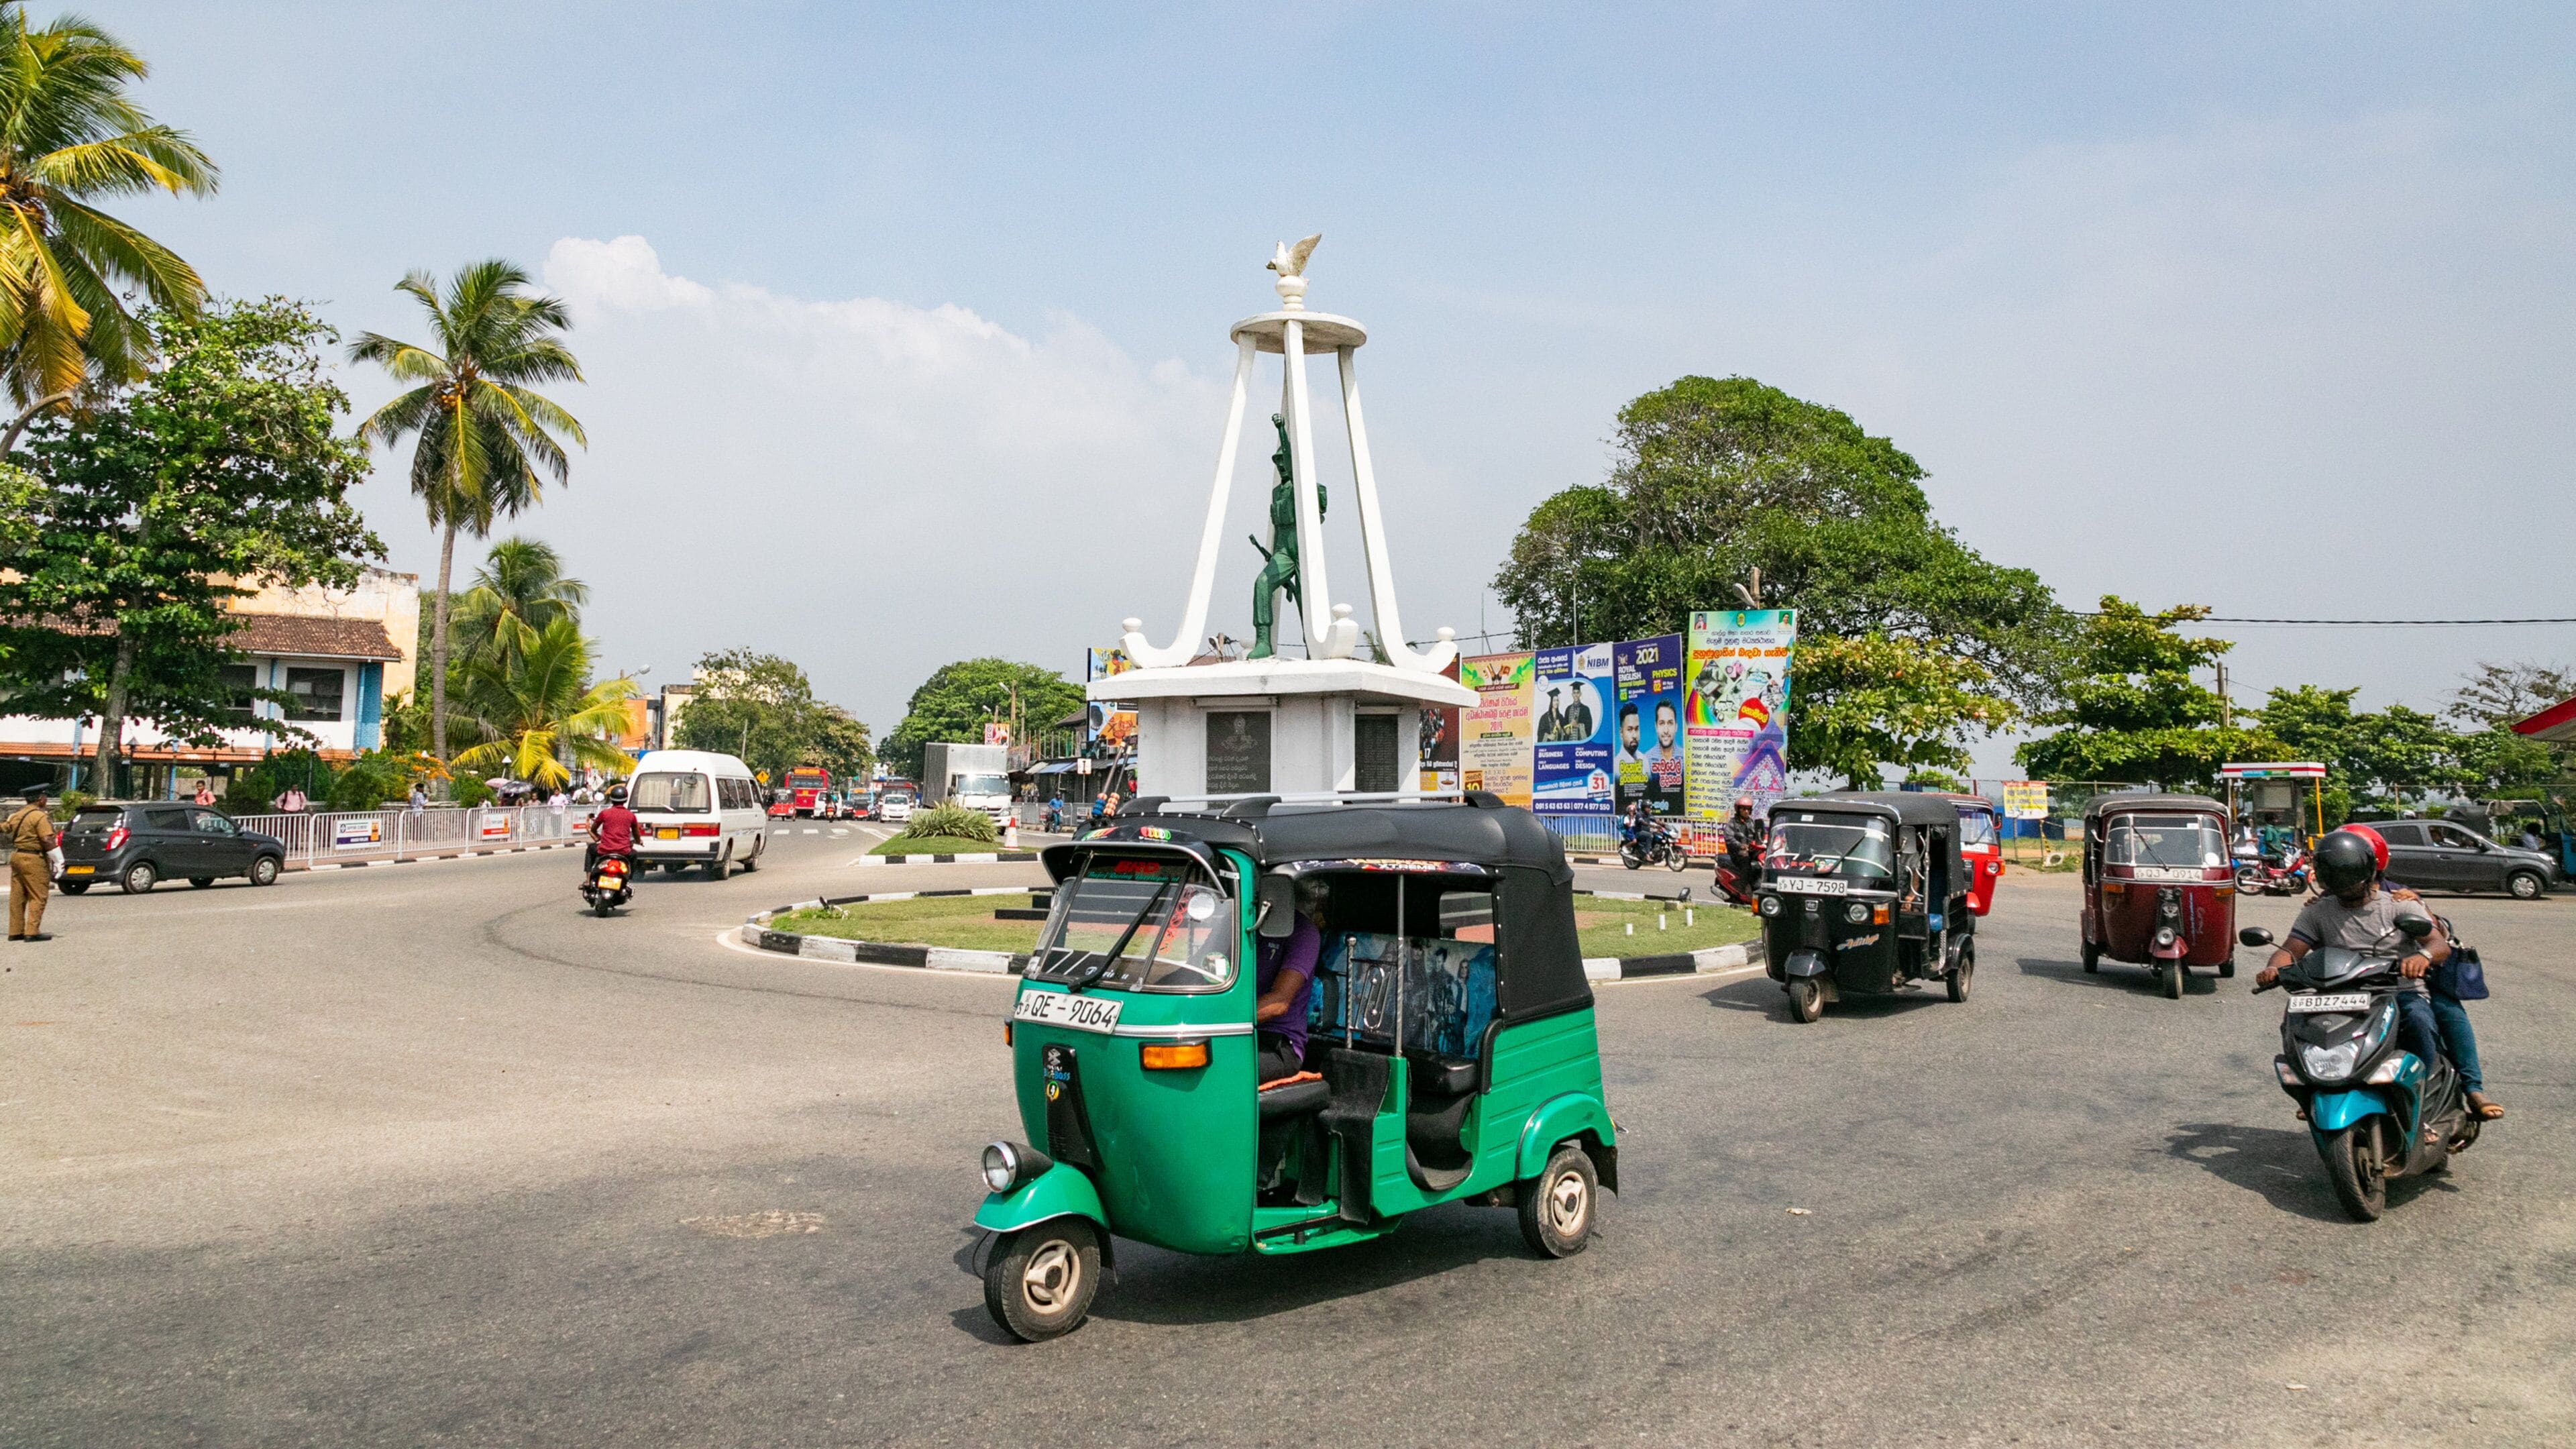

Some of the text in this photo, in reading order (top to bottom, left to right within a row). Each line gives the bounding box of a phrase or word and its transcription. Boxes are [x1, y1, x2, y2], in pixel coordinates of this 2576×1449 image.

[1636, 647, 1659, 665] 2021
[1587, 658, 1609, 667] NIBM
[1618, 665, 1636, 674] ROYAL
[1652, 668, 1677, 679] PHYSICS
[1618, 672, 1642, 682] ENGLISH
[1490, 721, 1503, 731] 2019
[1424, 748, 1431, 759] 17
[1466, 782, 1480, 790] 10
[1593, 777, 1605, 790] 31
[2174, 870, 2200, 879] 0914
[1790, 879, 1804, 891] YJ
[1817, 881, 1845, 894] 7598
[2306, 996, 2367, 1007] BDZ7444
[1030, 994, 1055, 1018] QE
[1069, 1000, 1115, 1028] 9064
